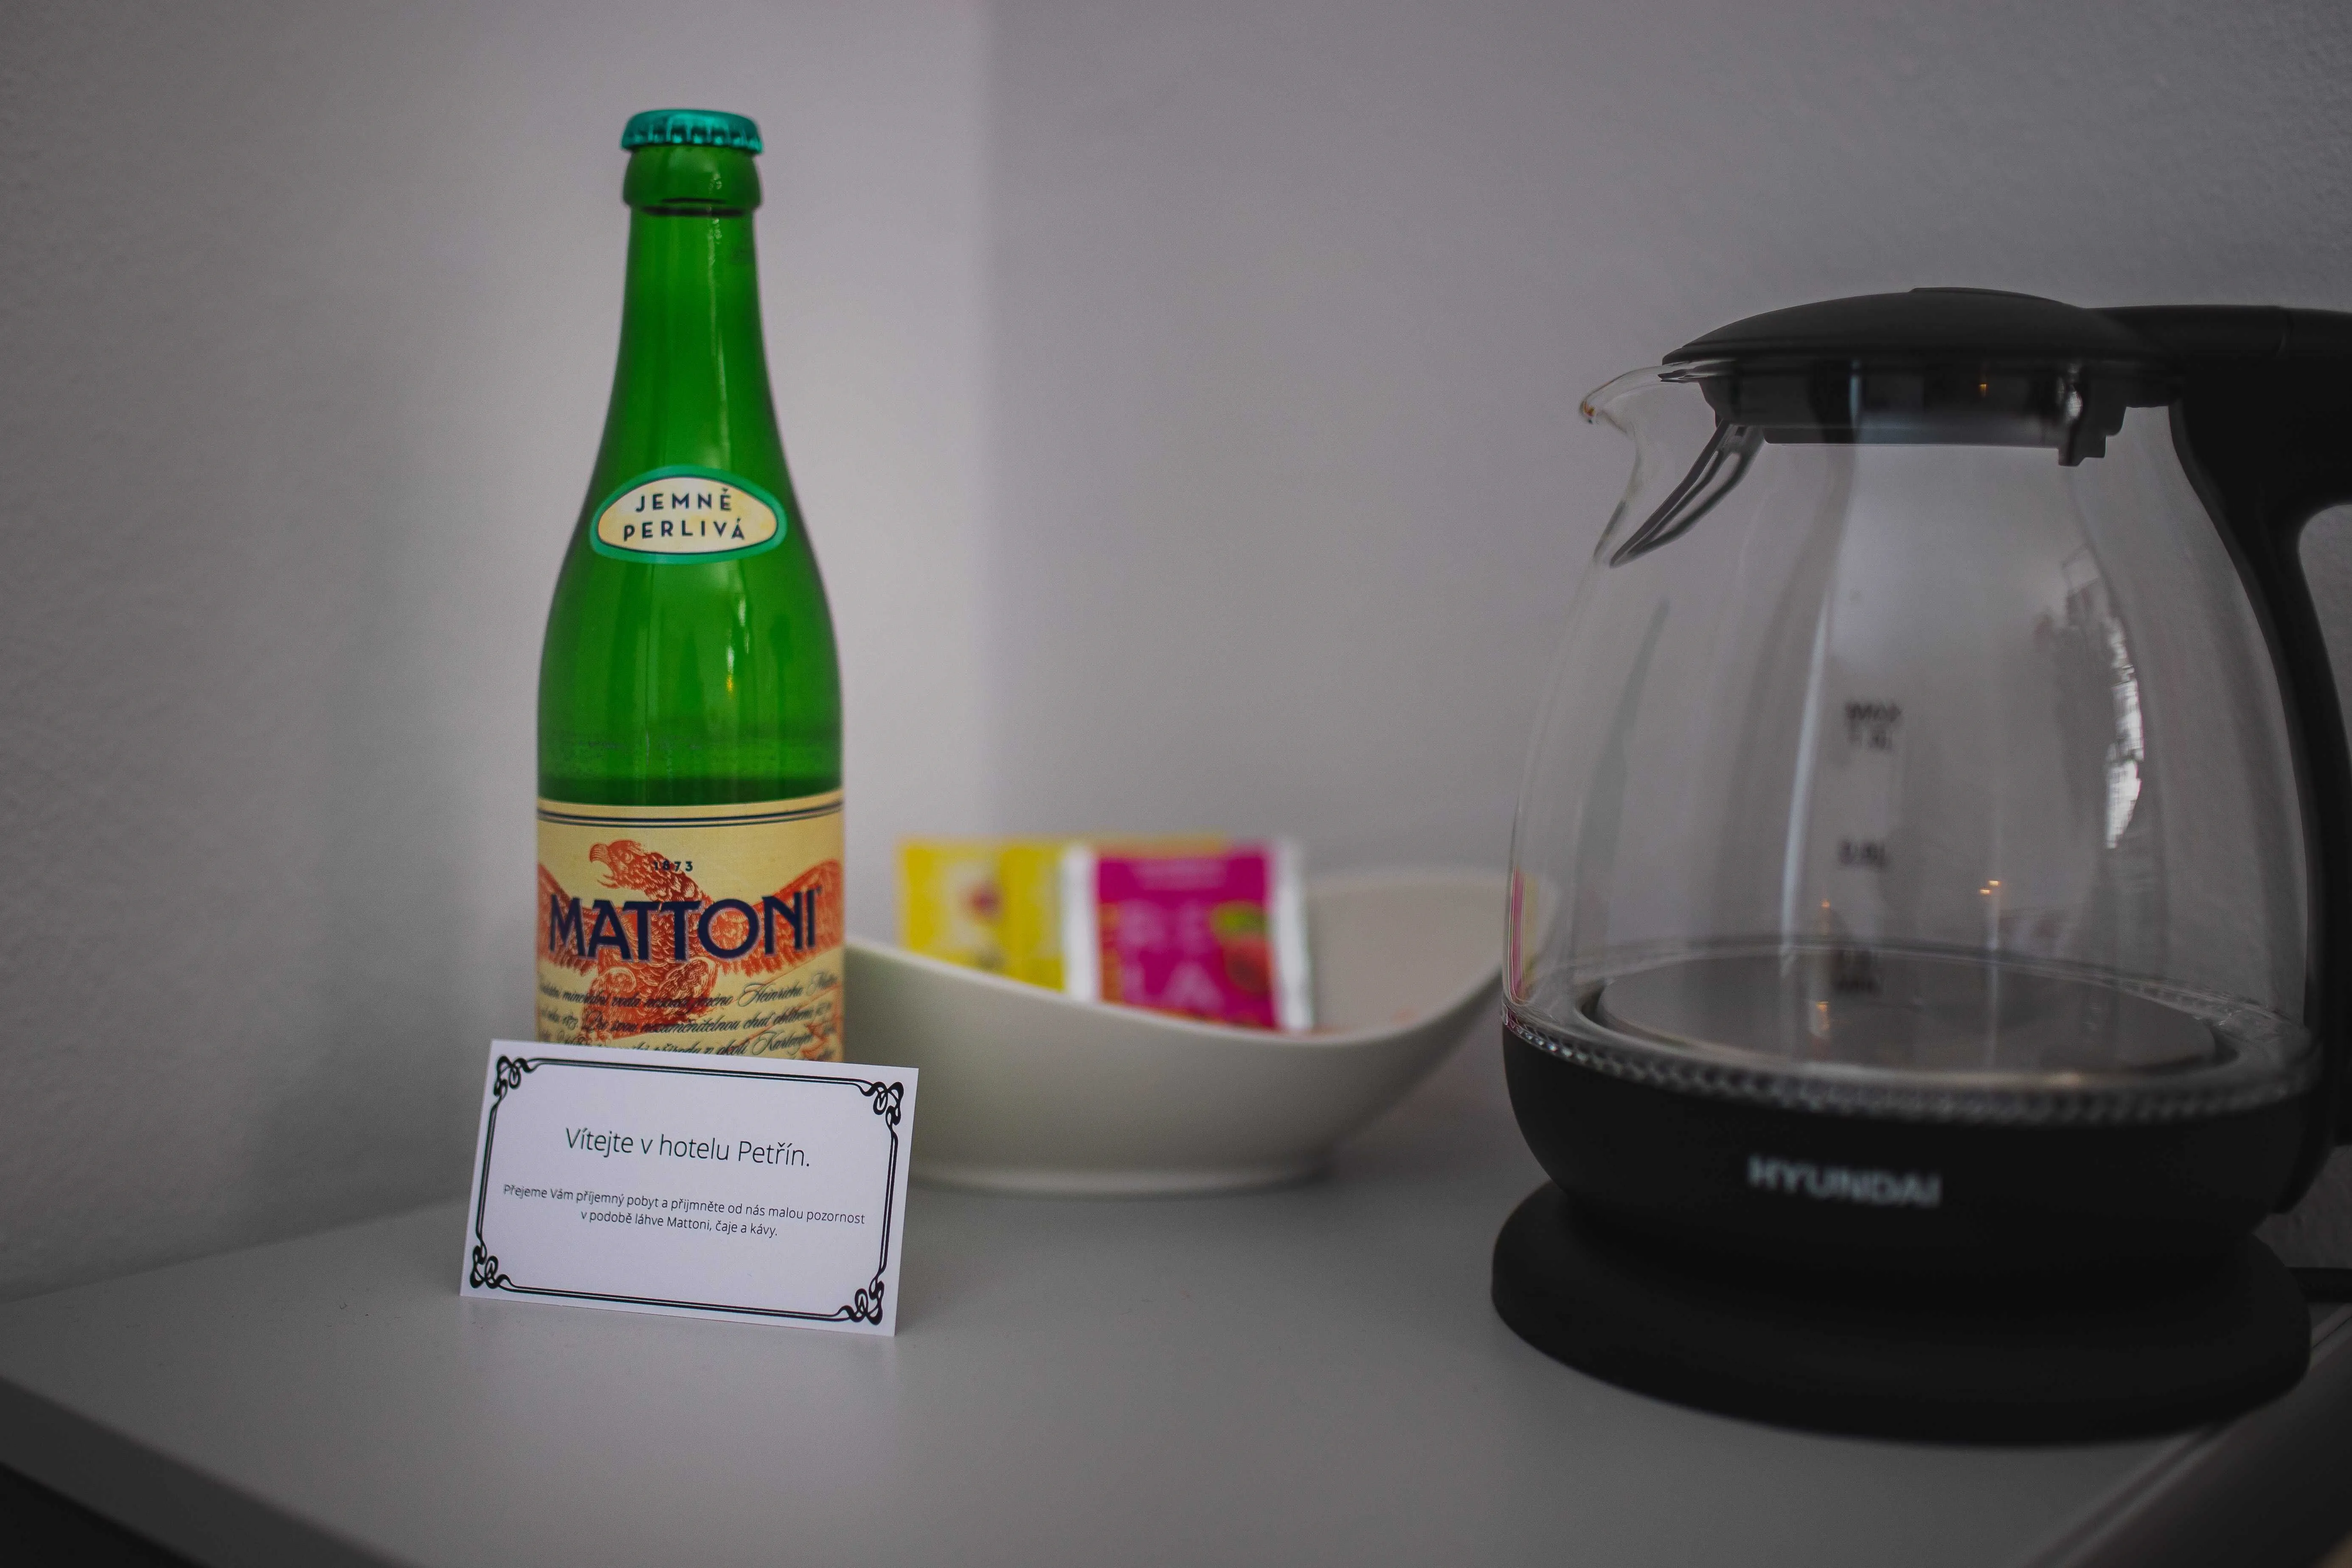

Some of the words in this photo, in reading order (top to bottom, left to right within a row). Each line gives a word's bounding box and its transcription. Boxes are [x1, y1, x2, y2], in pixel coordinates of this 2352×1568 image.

[635, 487, 732, 513] JEMNĚ
[624, 517, 745, 542] PERLIVÁ
[653, 859, 693, 872] 1873
[550, 888, 818, 962] MATTONI
[565, 1127, 634, 1158] Vítejte
[641, 1138, 653, 1155] v
[659, 1133, 729, 1161] hotelu
[738, 1141, 810, 1167] Petřín.
[503, 1184, 548, 1199] Přejeme
[550, 1189, 573, 1201] Vám
[576, 1190, 625, 1207] příjemný
[627, 1195, 659, 1210] pobyt
[661, 1199, 668, 1208] a
[671, 1198, 725, 1213] přijmněte
[728, 1203, 742, 1214] od
[745, 1204, 765, 1216] nás
[768, 1206, 804, 1220] malou
[806, 1210, 865, 1225] pozornost
[581, 1211, 587, 1220] v
[589, 1210, 632, 1224] podobě
[635, 1213, 664, 1227] láhve
[666, 1217, 712, 1232] Mattoni,
[715, 1221, 738, 1235] čaje
[740, 1225, 747, 1234] a
[750, 1222, 778, 1239] kávy.
